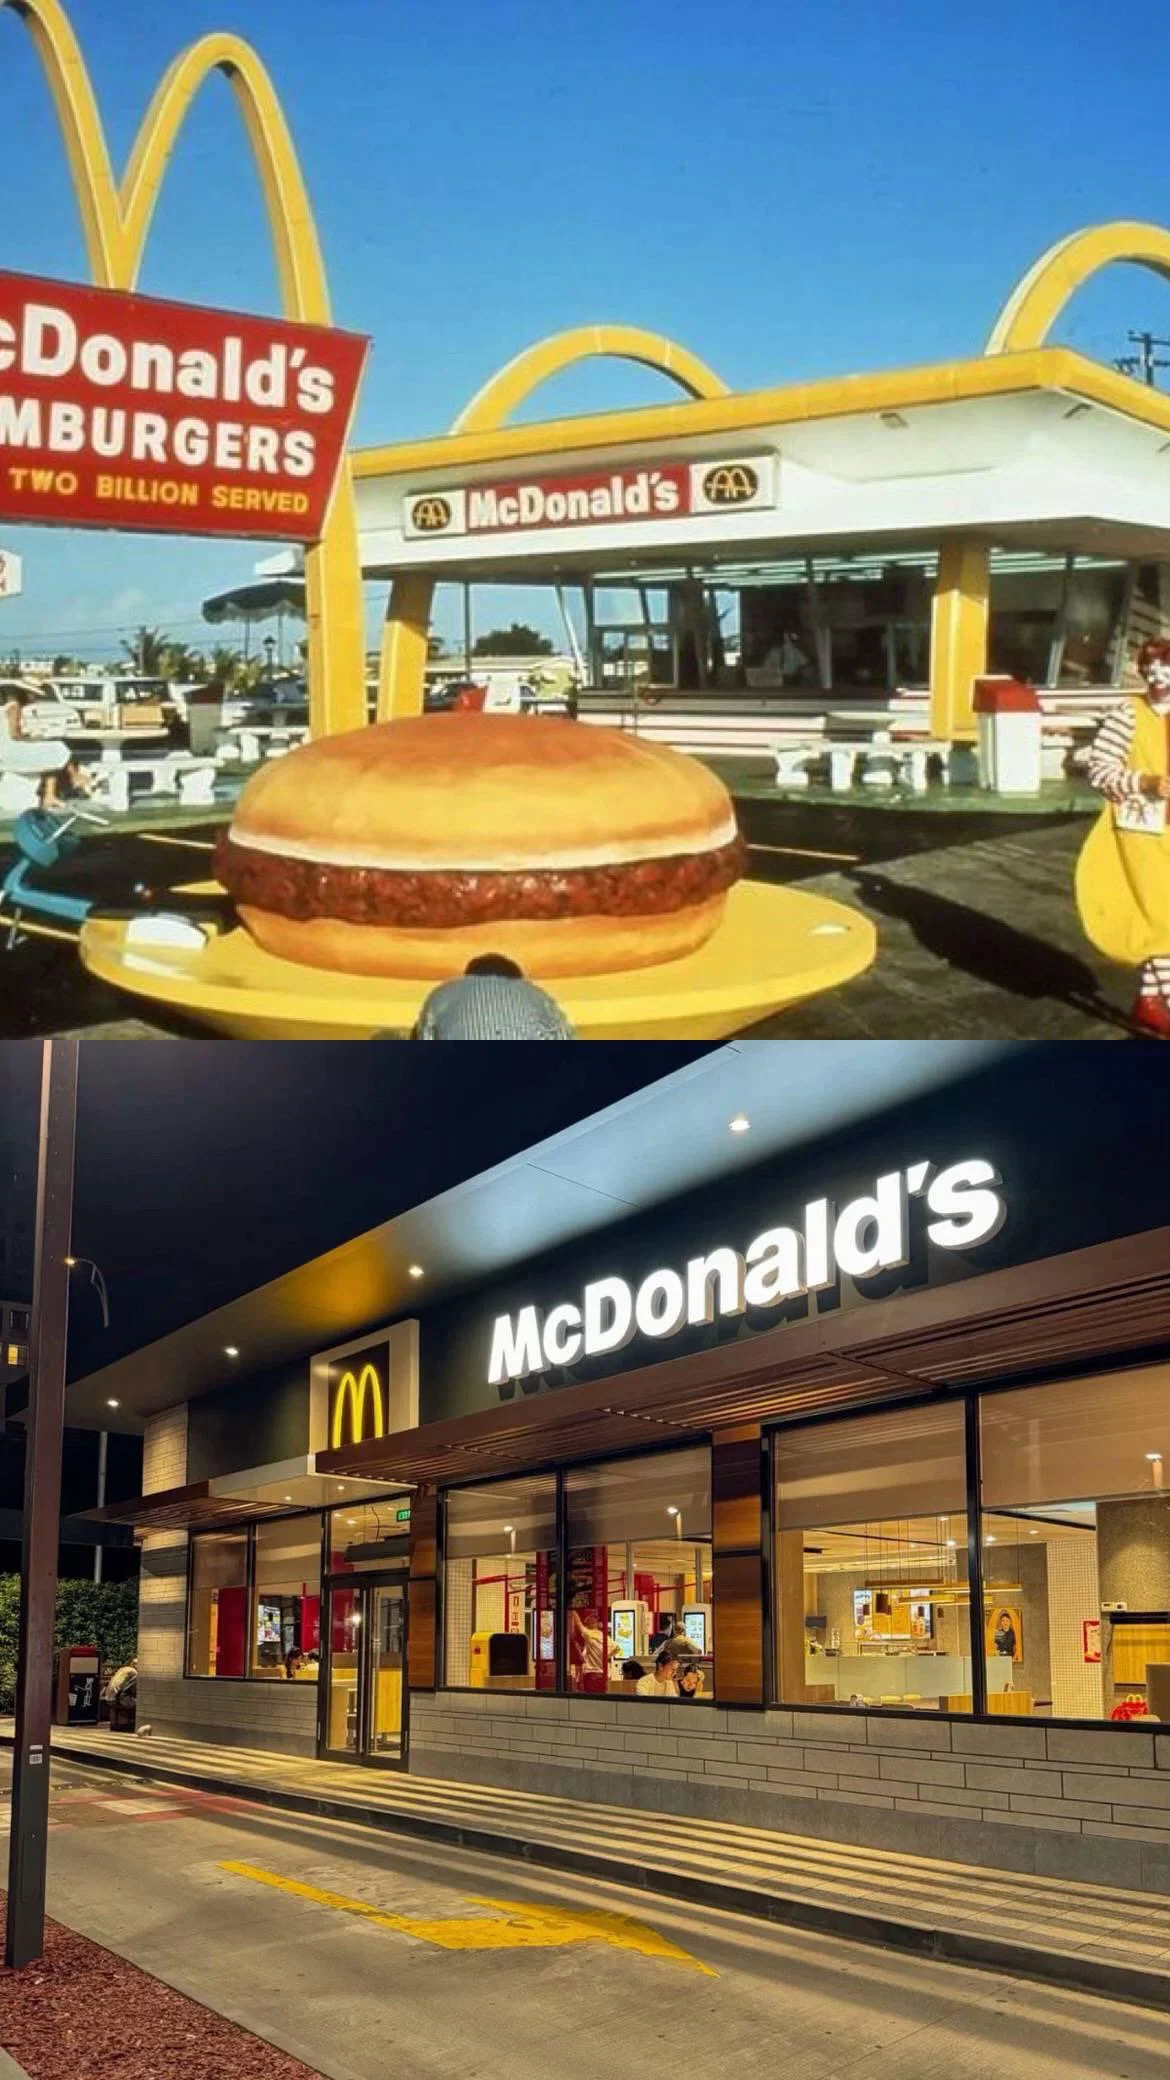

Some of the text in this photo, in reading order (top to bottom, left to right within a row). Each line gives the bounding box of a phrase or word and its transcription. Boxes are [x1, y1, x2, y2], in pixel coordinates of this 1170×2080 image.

[0, 395, 316, 476] MBURGERS
[9, 467, 309, 514] TWO BILLION SERVED
[469, 472, 680, 528] McDonald's
[487, 1159, 1004, 1385] McDonald's
